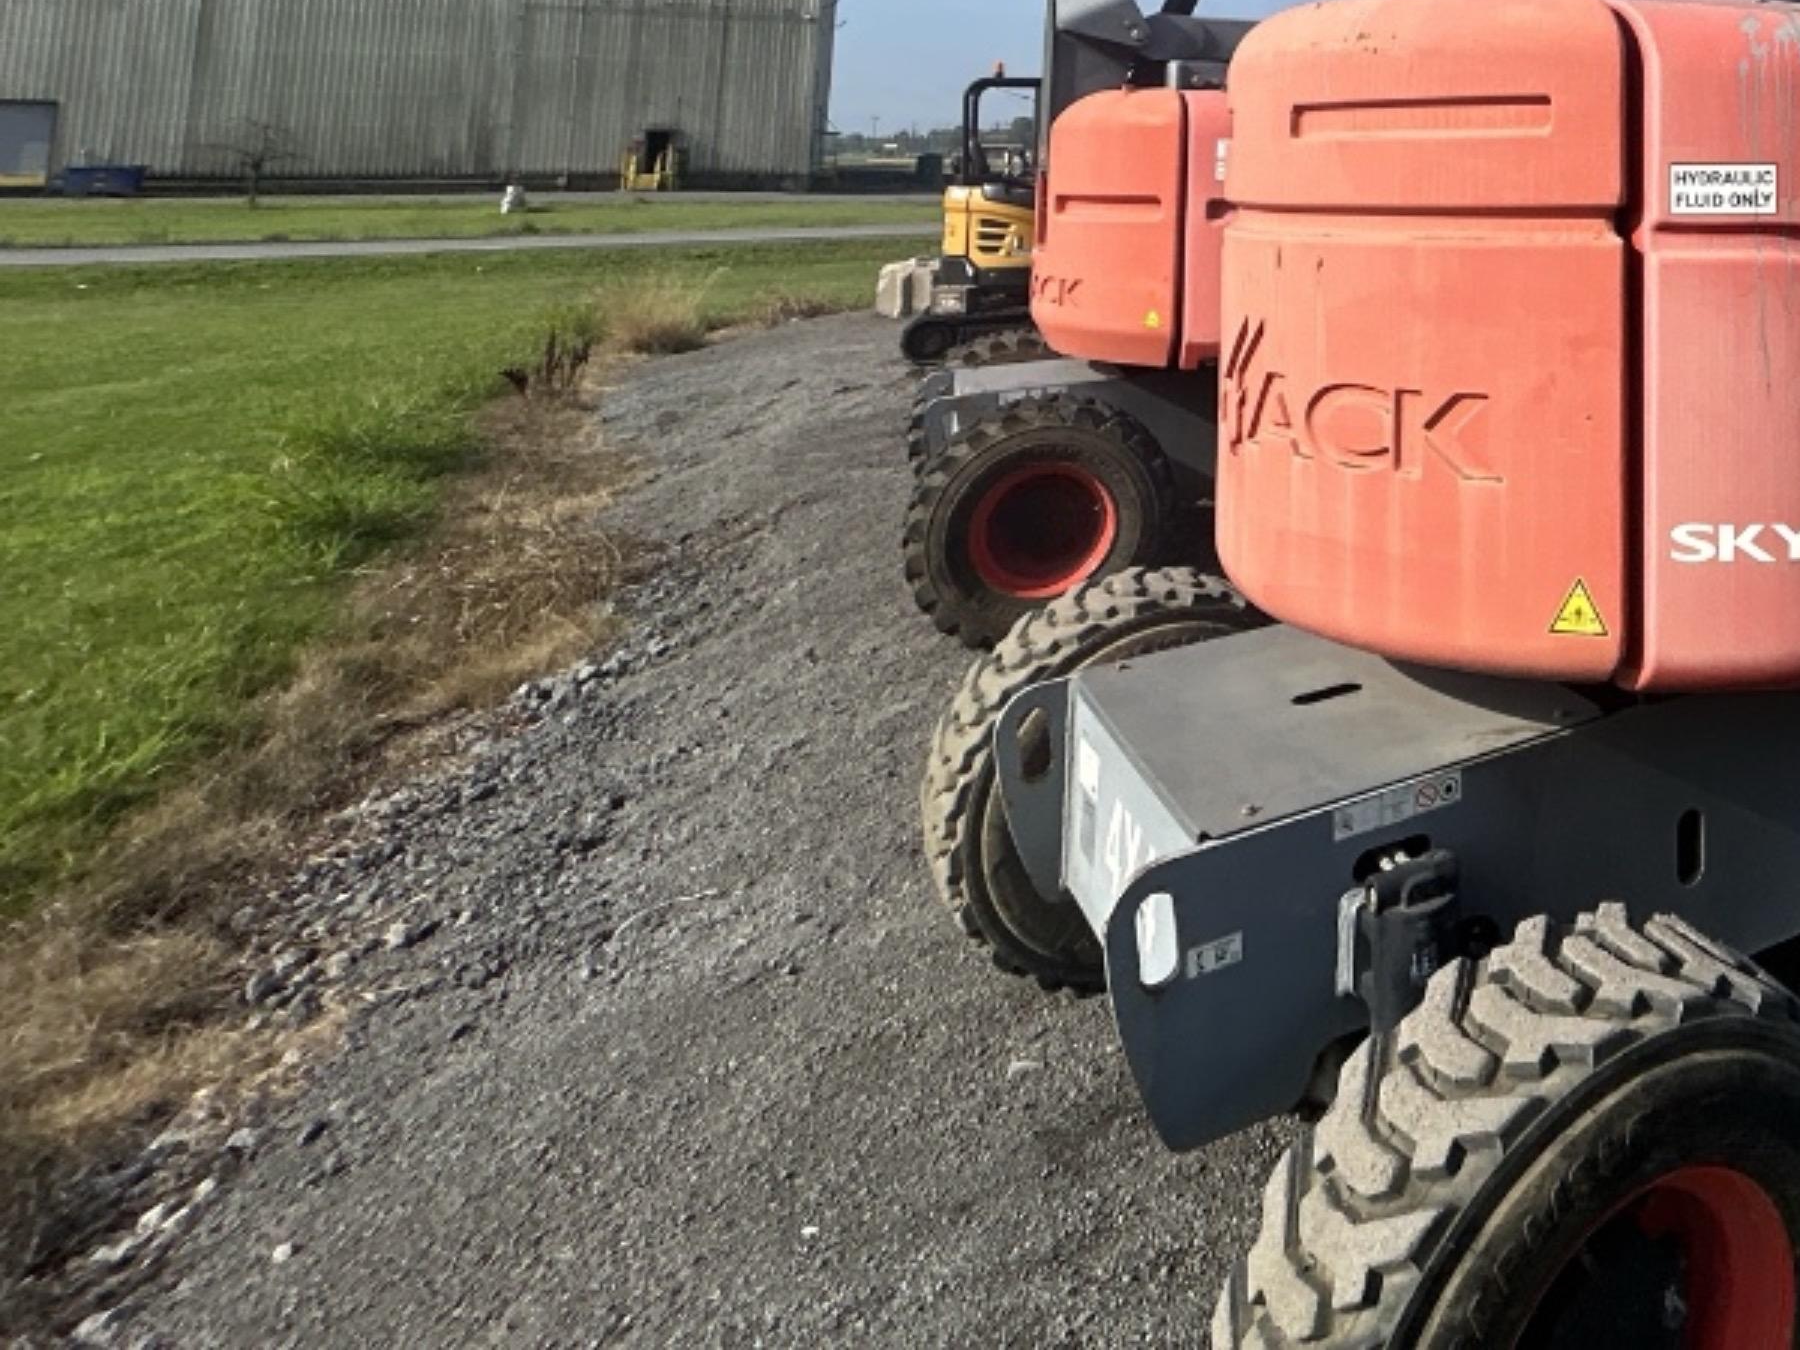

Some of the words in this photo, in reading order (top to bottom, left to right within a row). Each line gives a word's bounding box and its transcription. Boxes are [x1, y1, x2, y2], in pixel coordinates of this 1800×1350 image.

[1674, 170, 1774, 187] HYDRAULIC
[1675, 191, 1724, 208] FLUID
[1728, 189, 1773, 209] ONLY
